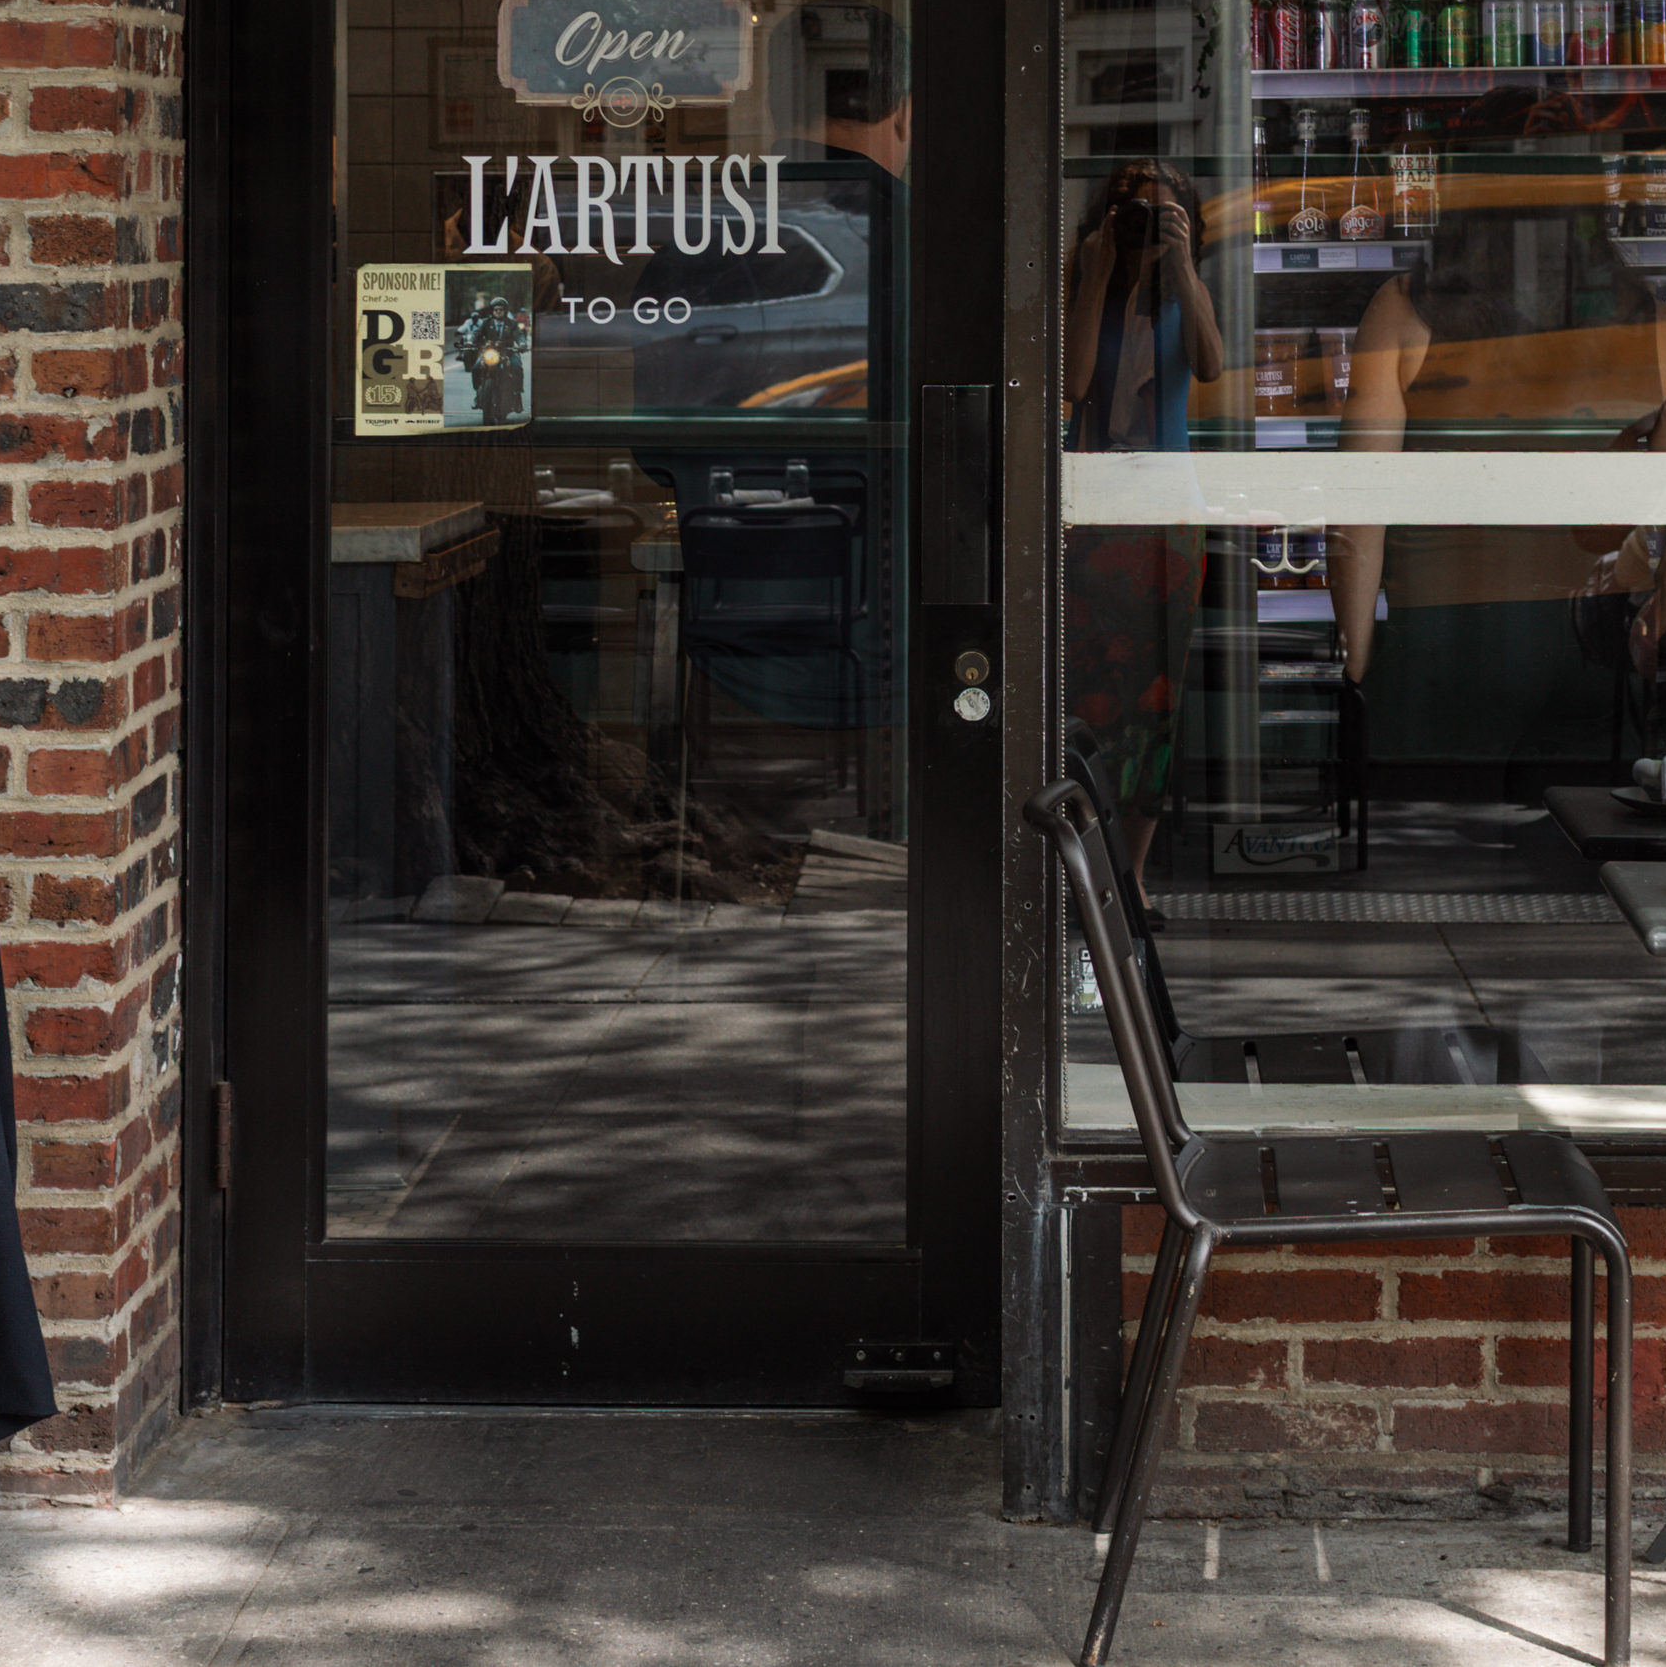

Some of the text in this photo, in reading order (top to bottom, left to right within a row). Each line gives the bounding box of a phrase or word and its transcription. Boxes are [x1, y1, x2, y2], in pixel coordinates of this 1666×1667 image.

[554, 10, 696, 76] Open
[1394, 157, 1436, 169] JOE TEA
[1395, 171, 1435, 183] HALF
[462, 153, 787, 267] L'ARTUSI
[1295, 216, 1325, 233] cola
[1344, 216, 1376, 234] ginger
[362, 271, 441, 291] SPONSOR ME!
[362, 295, 399, 303] Chef Joe
[561, 295, 693, 325] TO GO
[370, 384, 396, 405] 15
